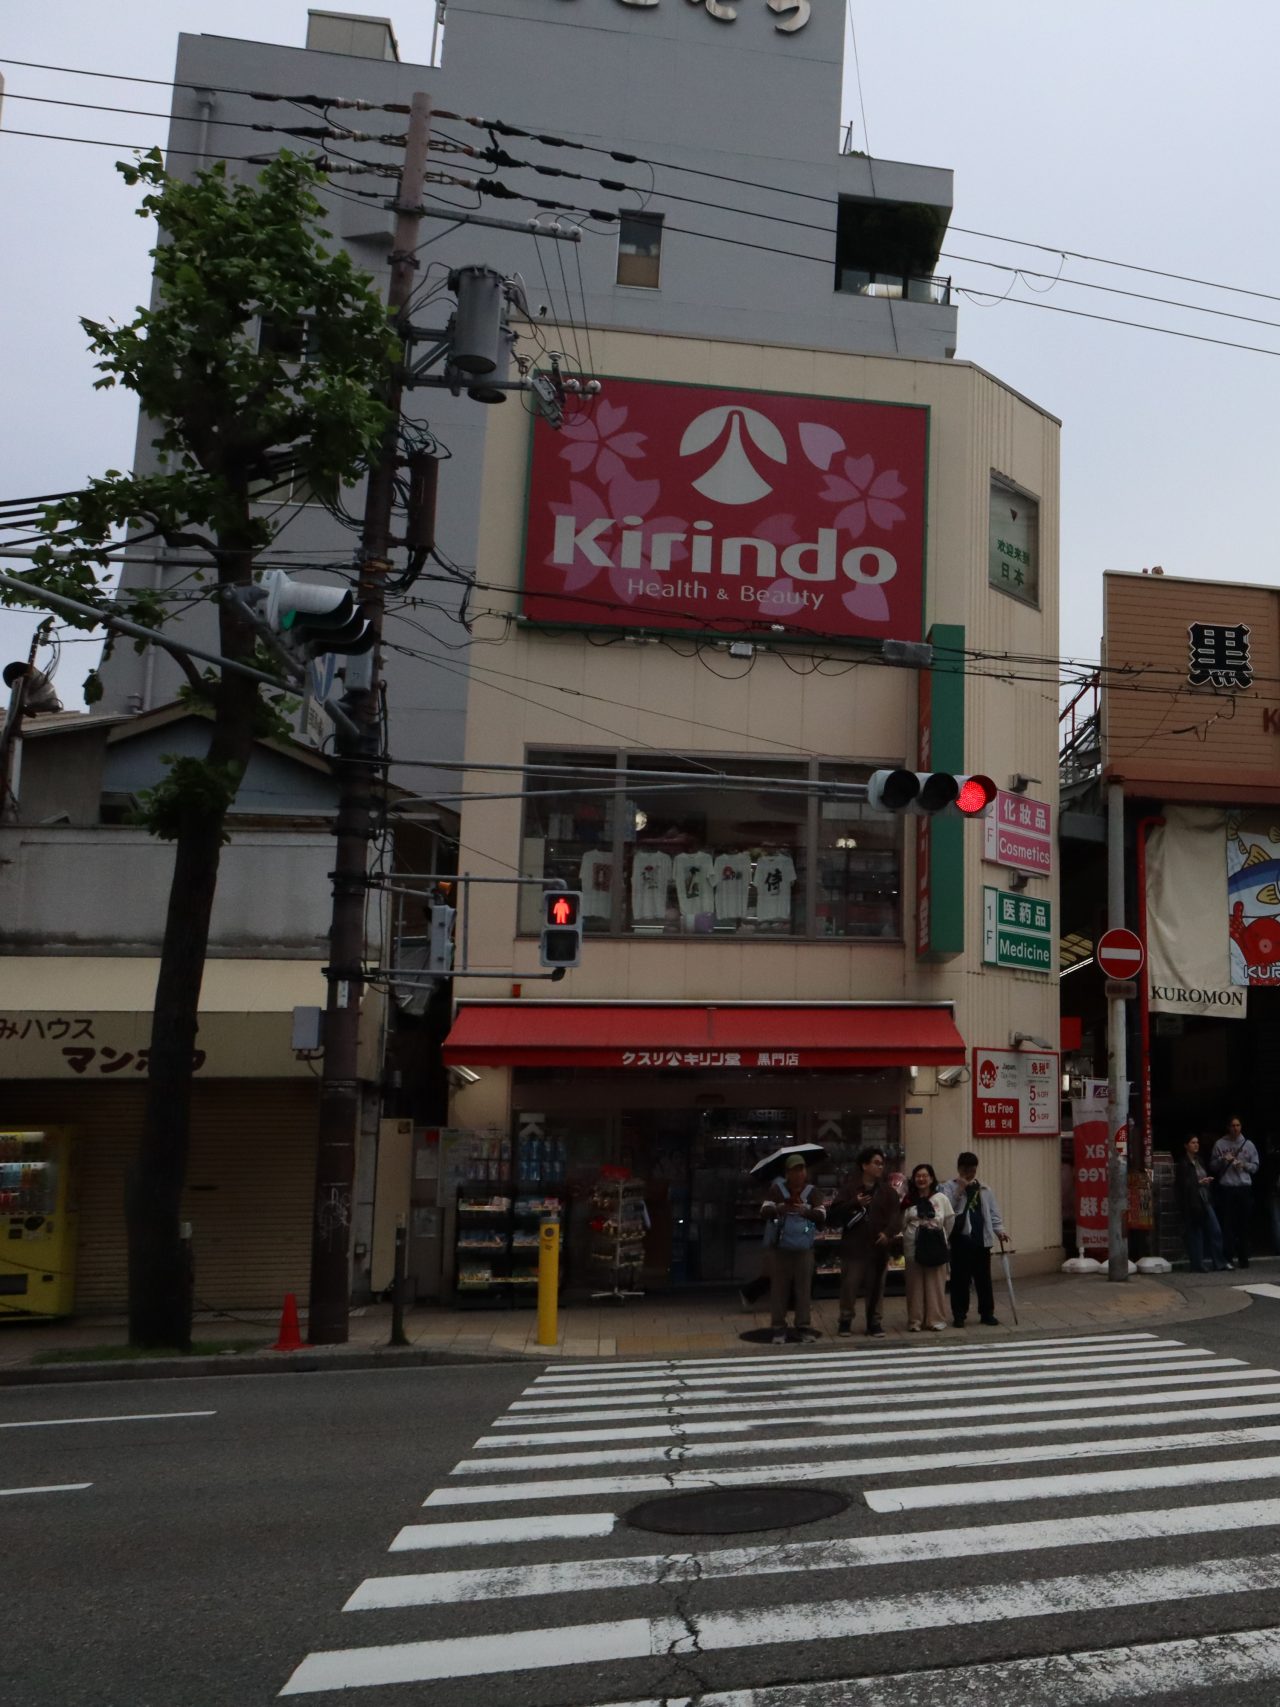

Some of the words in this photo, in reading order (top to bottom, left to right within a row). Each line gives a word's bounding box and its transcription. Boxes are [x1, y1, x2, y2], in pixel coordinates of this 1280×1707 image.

[553, 514, 898, 585] Kirindo
[1001, 562, 1024, 585] 日本
[627, 578, 708, 600] Health
[716, 587, 729, 600] &
[740, 585, 825, 610] Beauty
[1000, 837, 1049, 864] Cosmetics
[1000, 938, 1050, 962] Medicine
[1151, 985, 1243, 1006] KUROMON
[62, 1047, 206, 1073] マン
[622, 1051, 664, 1066] クスリ
[684, 1052, 741, 1066] キリン堂
[757, 1052, 800, 1066] 黒門店
[983, 1102, 997, 1114] Tax
[998, 1102, 1015, 1114] Free
